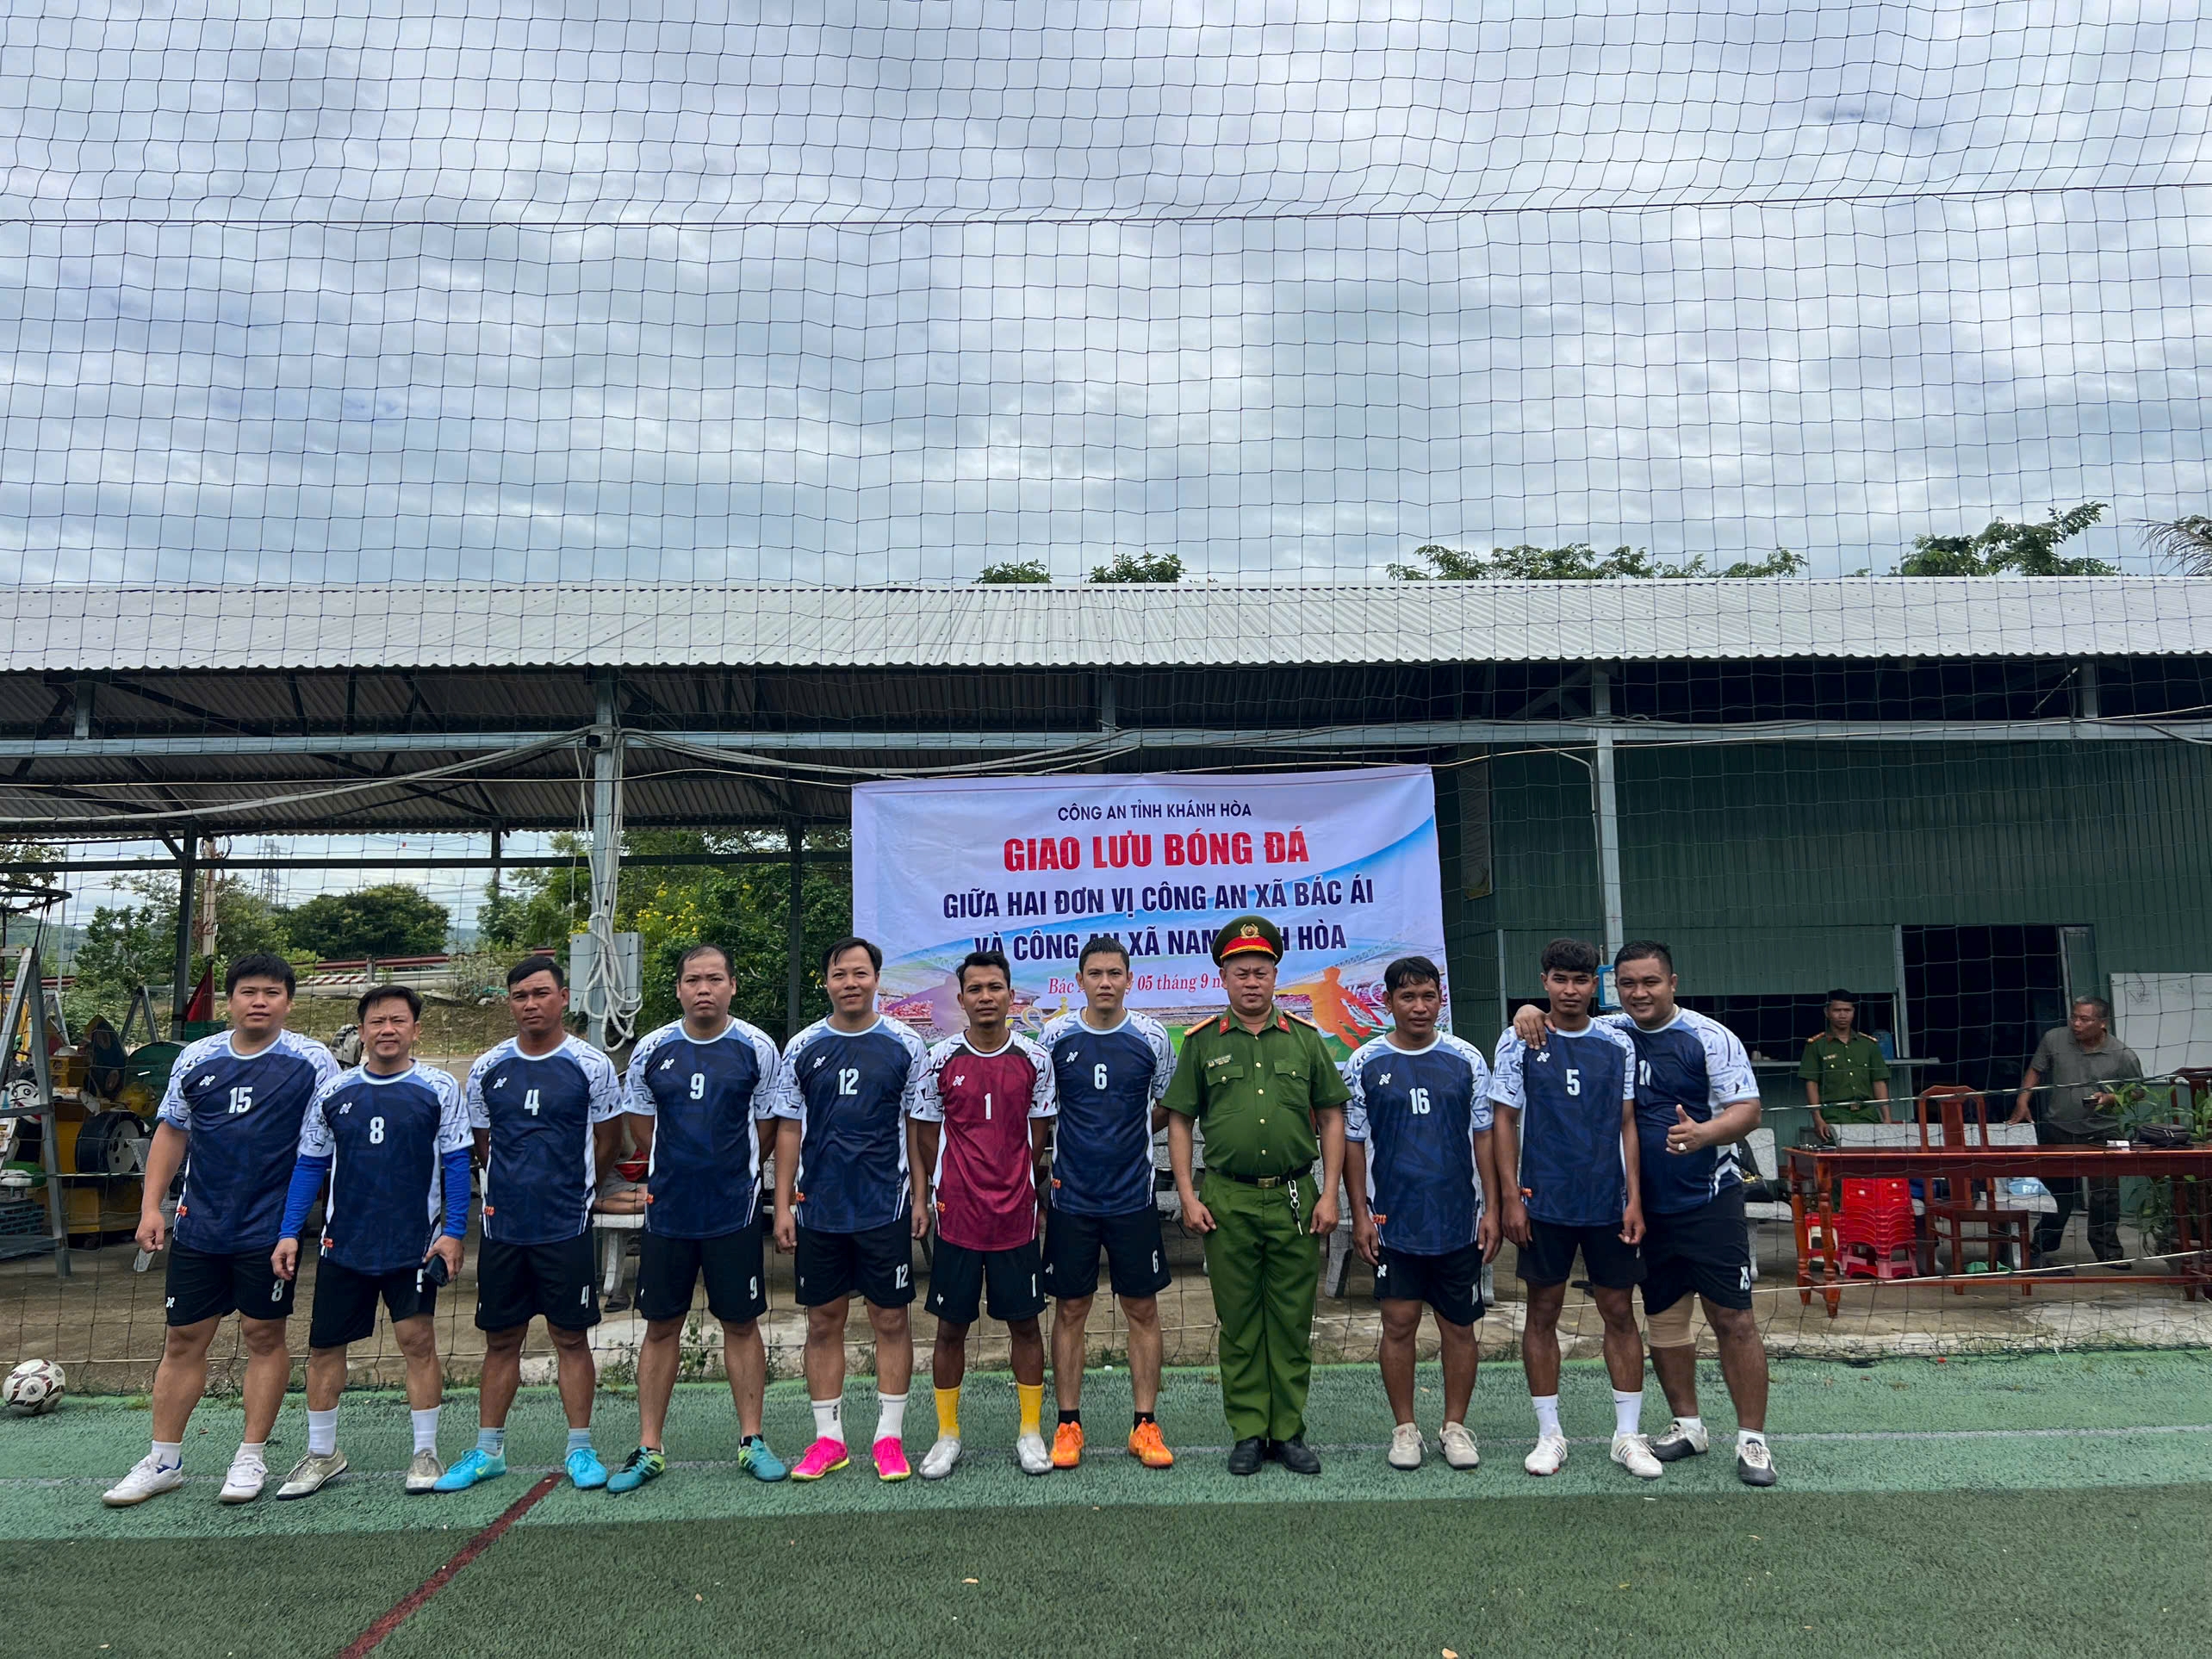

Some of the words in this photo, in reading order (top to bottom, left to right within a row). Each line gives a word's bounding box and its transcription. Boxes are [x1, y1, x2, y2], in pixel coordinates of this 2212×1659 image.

[1058, 803, 1103, 821] CÔNG
[1107, 805, 1127, 819] AN
[1131, 799, 1162, 818] TỈNH
[1167, 799, 1215, 818] KHÁNH
[1221, 800, 1252, 817] HÒA
[1004, 837, 1080, 872] GIAO
[1093, 830, 1152, 868] LƯU
[1164, 829, 1252, 867] BÓNG
[1264, 826, 1309, 863] ĐÁ
[943, 887, 999, 918] GIỮA
[1008, 891, 1047, 916] HAI
[1054, 887, 1103, 915] ĐƠN
[1111, 887, 1134, 917] VỊ
[1142, 881, 1206, 911] CÔNG
[1215, 885, 1246, 910] AN
[1255, 878, 1287, 908] XÃ
[1295, 876, 1341, 906] BÁC
[1351, 874, 1373, 904] ÁI
[1014, 931, 1078, 960] CÔNG
[1128, 926, 1160, 956] XÃ
[1298, 919, 1347, 950] HÒA
[1048, 978, 1074, 993] Bác
[1138, 975, 1153, 991] 05
[1157, 974, 1197, 992] tháng
[1200, 972, 1209, 989] 9
[690, 1073, 705, 1100] 9
[839, 1069, 859, 1096] 12
[1095, 1064, 1108, 1090] 6
[1566, 1069, 1580, 1096] 5
[228, 1087, 253, 1114] 15
[524, 1089, 539, 1116] 4
[984, 1093, 991, 1120] 1
[1409, 1088, 1430, 1115] 16
[370, 1116, 385, 1144] 8
[1152, 1249, 1159, 1274] 6
[271, 1278, 285, 1302] 8
[749, 1275, 758, 1301] 9
[895, 1264, 909, 1289] 12
[1031, 1273, 1037, 1298] 1
[581, 1284, 590, 1309] 4
